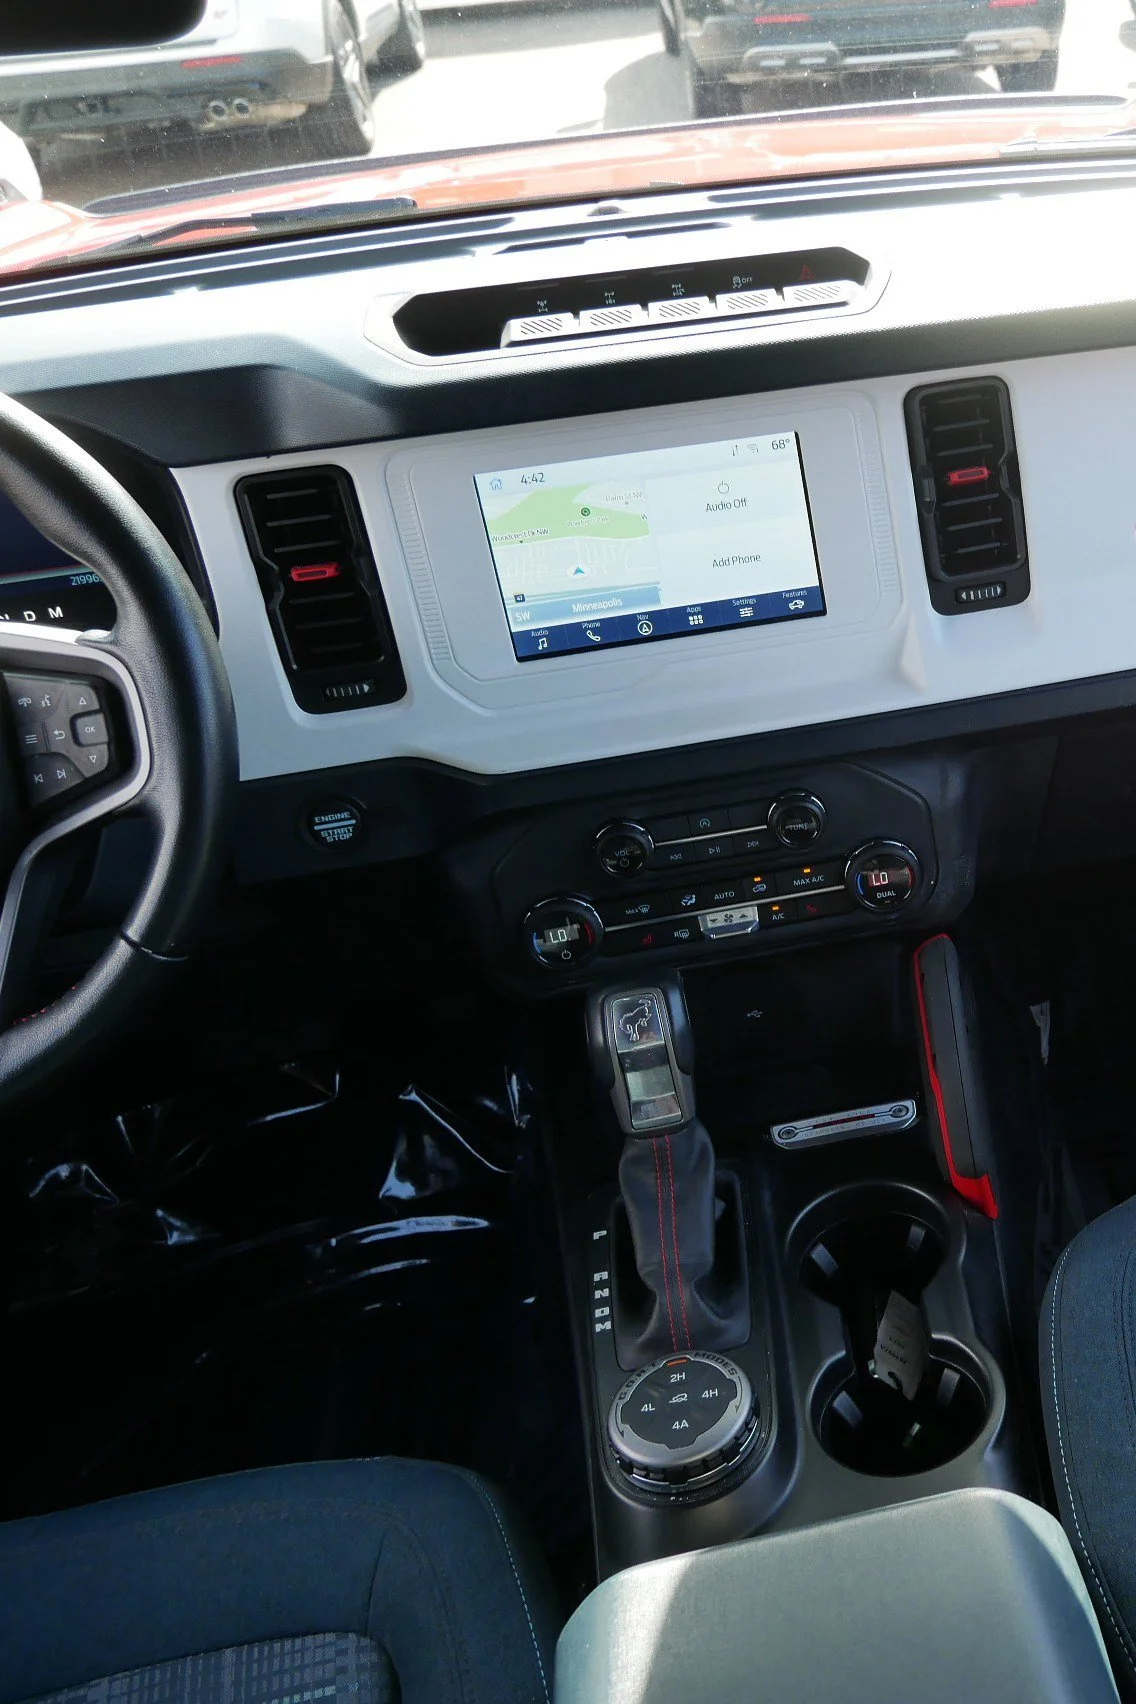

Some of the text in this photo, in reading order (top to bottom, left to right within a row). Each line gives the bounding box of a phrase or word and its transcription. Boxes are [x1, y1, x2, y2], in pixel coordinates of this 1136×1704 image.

[741, 276, 753, 284] OFF
[520, 472, 546, 485] 4:42
[705, 497, 748, 513] Audio Off
[536, 528, 550, 537] NW
[712, 553, 761, 568] Add Phone
[70, 574, 101, 586] 21996
[782, 589, 808, 599] Features
[572, 598, 623, 613] Minneapolis
[732, 597, 757, 607] Settings
[23, 610, 36, 621] D
[47, 606, 64, 619] M
[686, 606, 702, 614] Apps
[515, 611, 531, 622] SW
[636, 613, 649, 621] Nav
[582, 621, 601, 630] Phone
[531, 629, 549, 638] Audio
[85, 725, 96, 733] OK
[314, 811, 351, 823] ENGINE
[320, 826, 354, 838] START
[326, 832, 353, 843] STOP
[614, 849, 631, 857] VOL
[793, 875, 825, 887] MAX A/C
[714, 890, 735, 901] AUTO
[876, 890, 897, 899] DUAL
[772, 912, 786, 921] A/C
[593, 1230, 607, 1240] P
[594, 1288, 610, 1299] N
[595, 1306, 610, 1318] D
[595, 1320, 612, 1333] M
[694, 1351, 738, 1376] MODES
[670, 1371, 686, 1383] 2H
[701, 1388, 719, 1399] 4H
[640, 1402, 656, 1412] 4L
[671, 1419, 690, 1430] 4A
